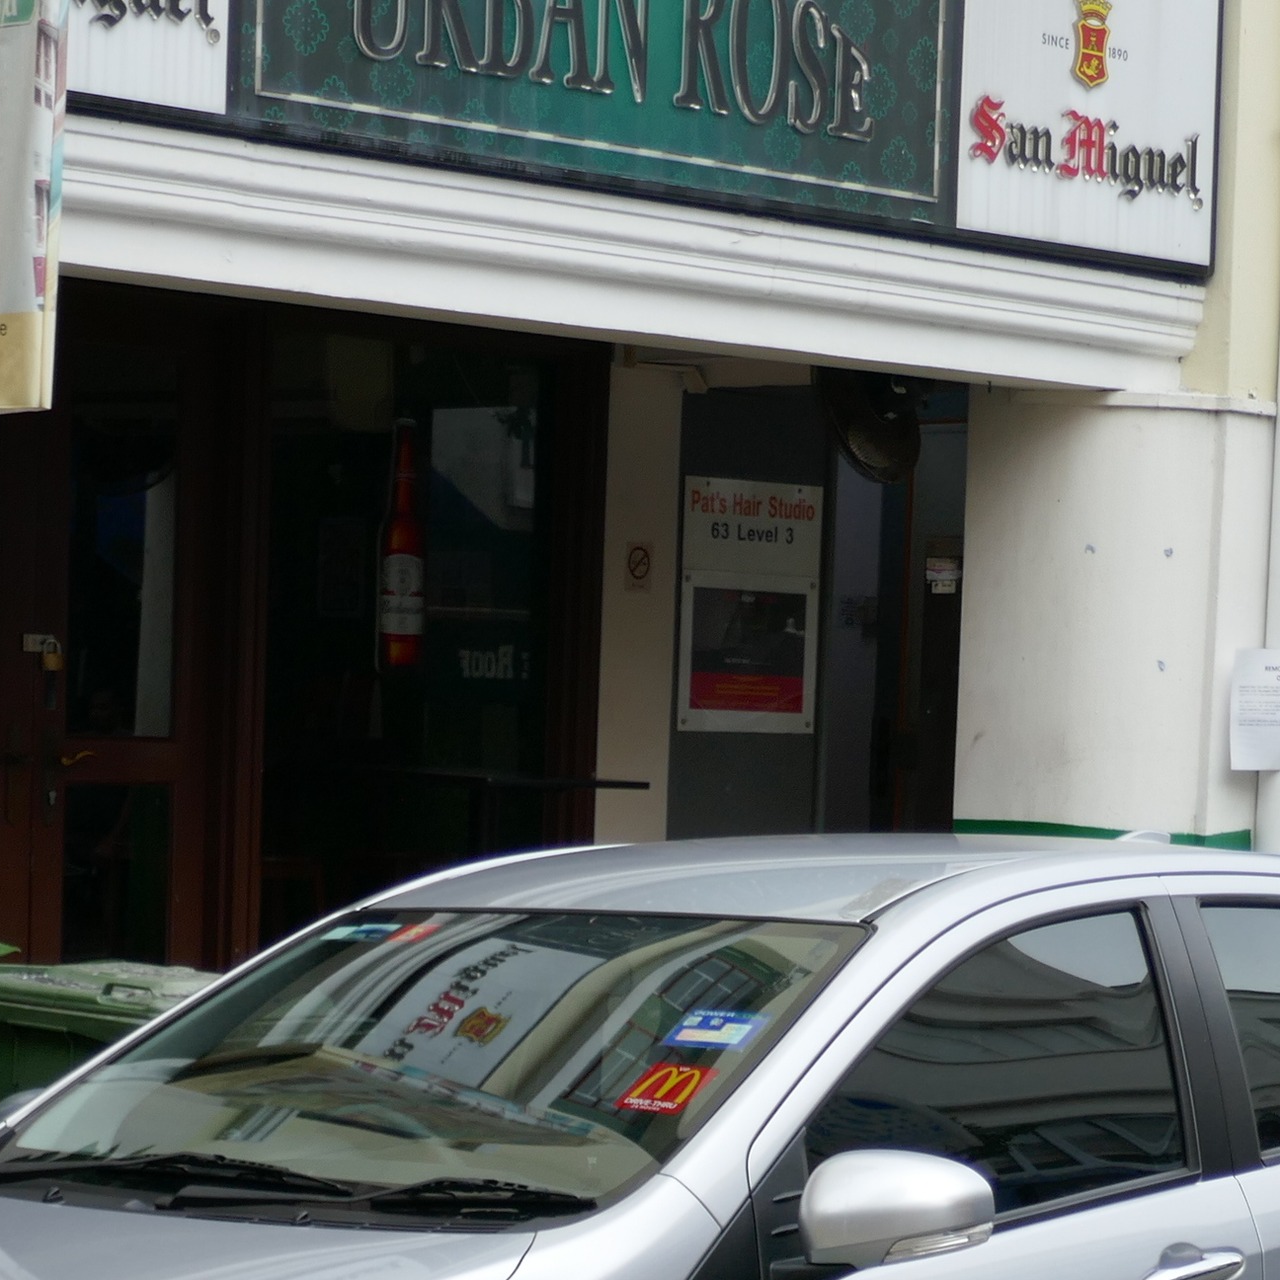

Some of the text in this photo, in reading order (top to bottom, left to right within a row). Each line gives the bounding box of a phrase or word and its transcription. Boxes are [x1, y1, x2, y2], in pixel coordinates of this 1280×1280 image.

[1041, 33, 1129, 62] SINCE 1890
[673, 0, 875, 142] ROSE
[968, 95, 1201, 200] San Miguel
[691, 489, 816, 521] Pat's Hair Studio
[711, 522, 794, 544] 63 Level 3
[623, 1097, 678, 1110] DRIVE-THRU
